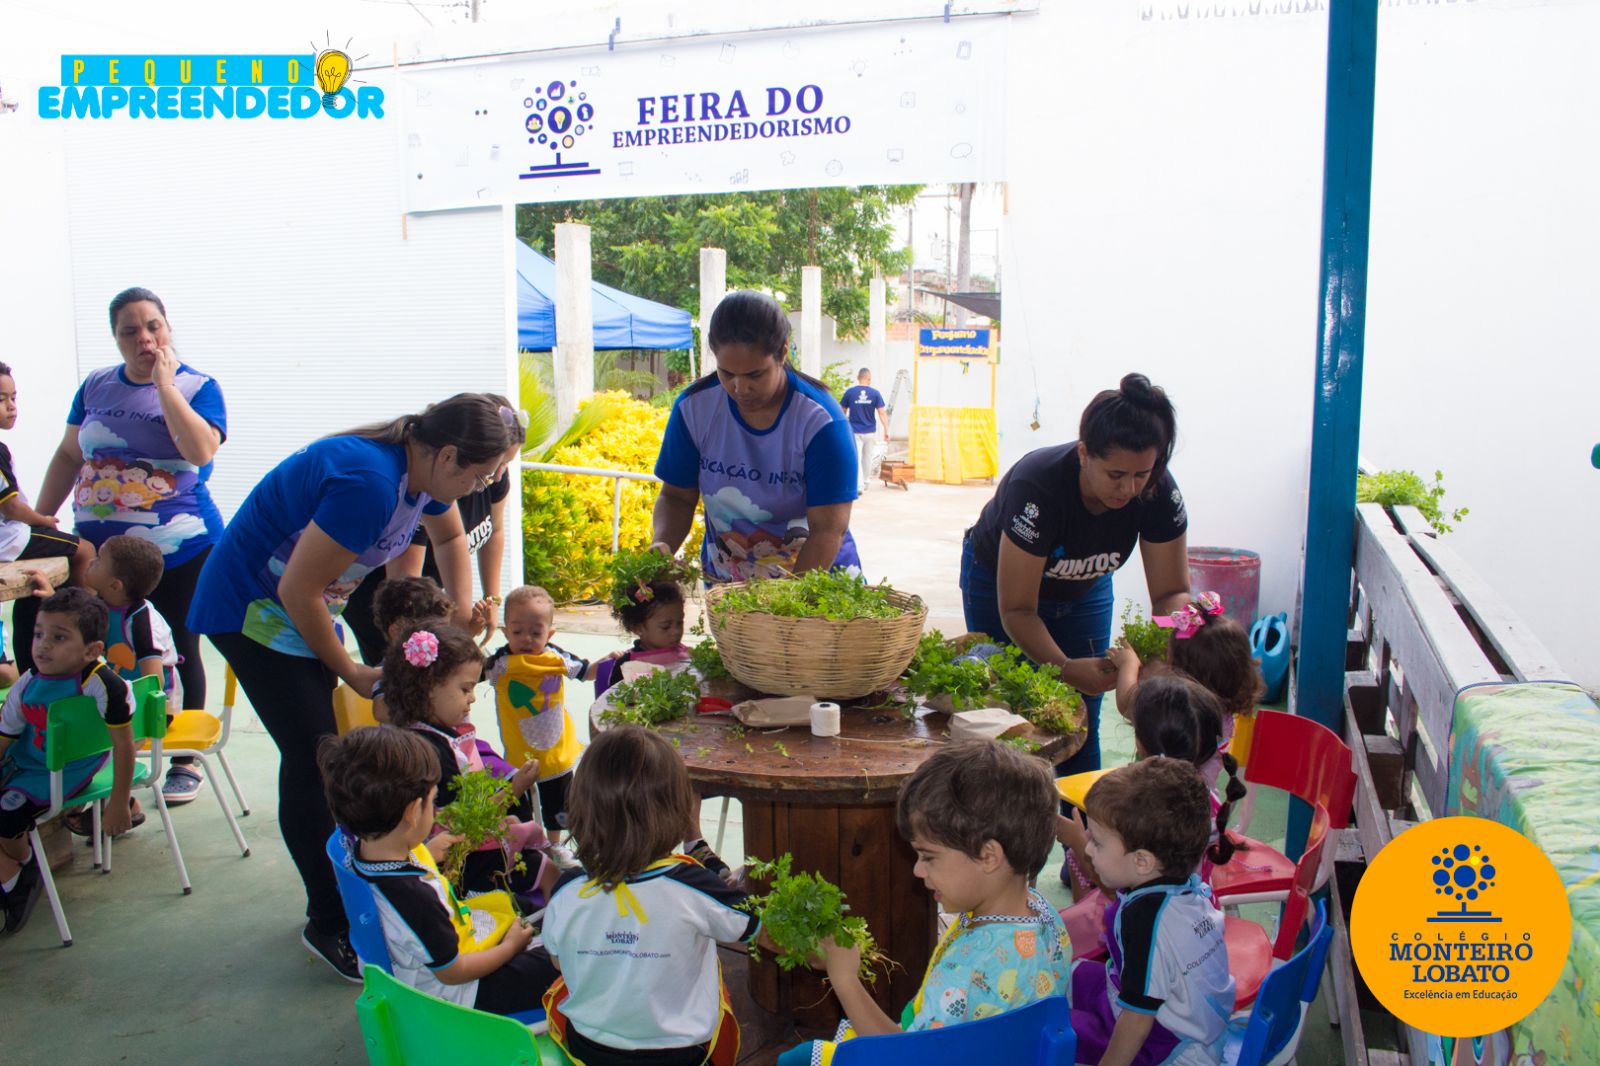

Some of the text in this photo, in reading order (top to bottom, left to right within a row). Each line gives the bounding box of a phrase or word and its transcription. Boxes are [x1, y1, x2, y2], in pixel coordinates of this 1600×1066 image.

[637, 84, 824, 126] FEIRA DO
[612, 115, 852, 148] EMPREENDEDORISMO
[466, 515, 493, 549] NTOS
[1049, 552, 1121, 577] JUNTOS
